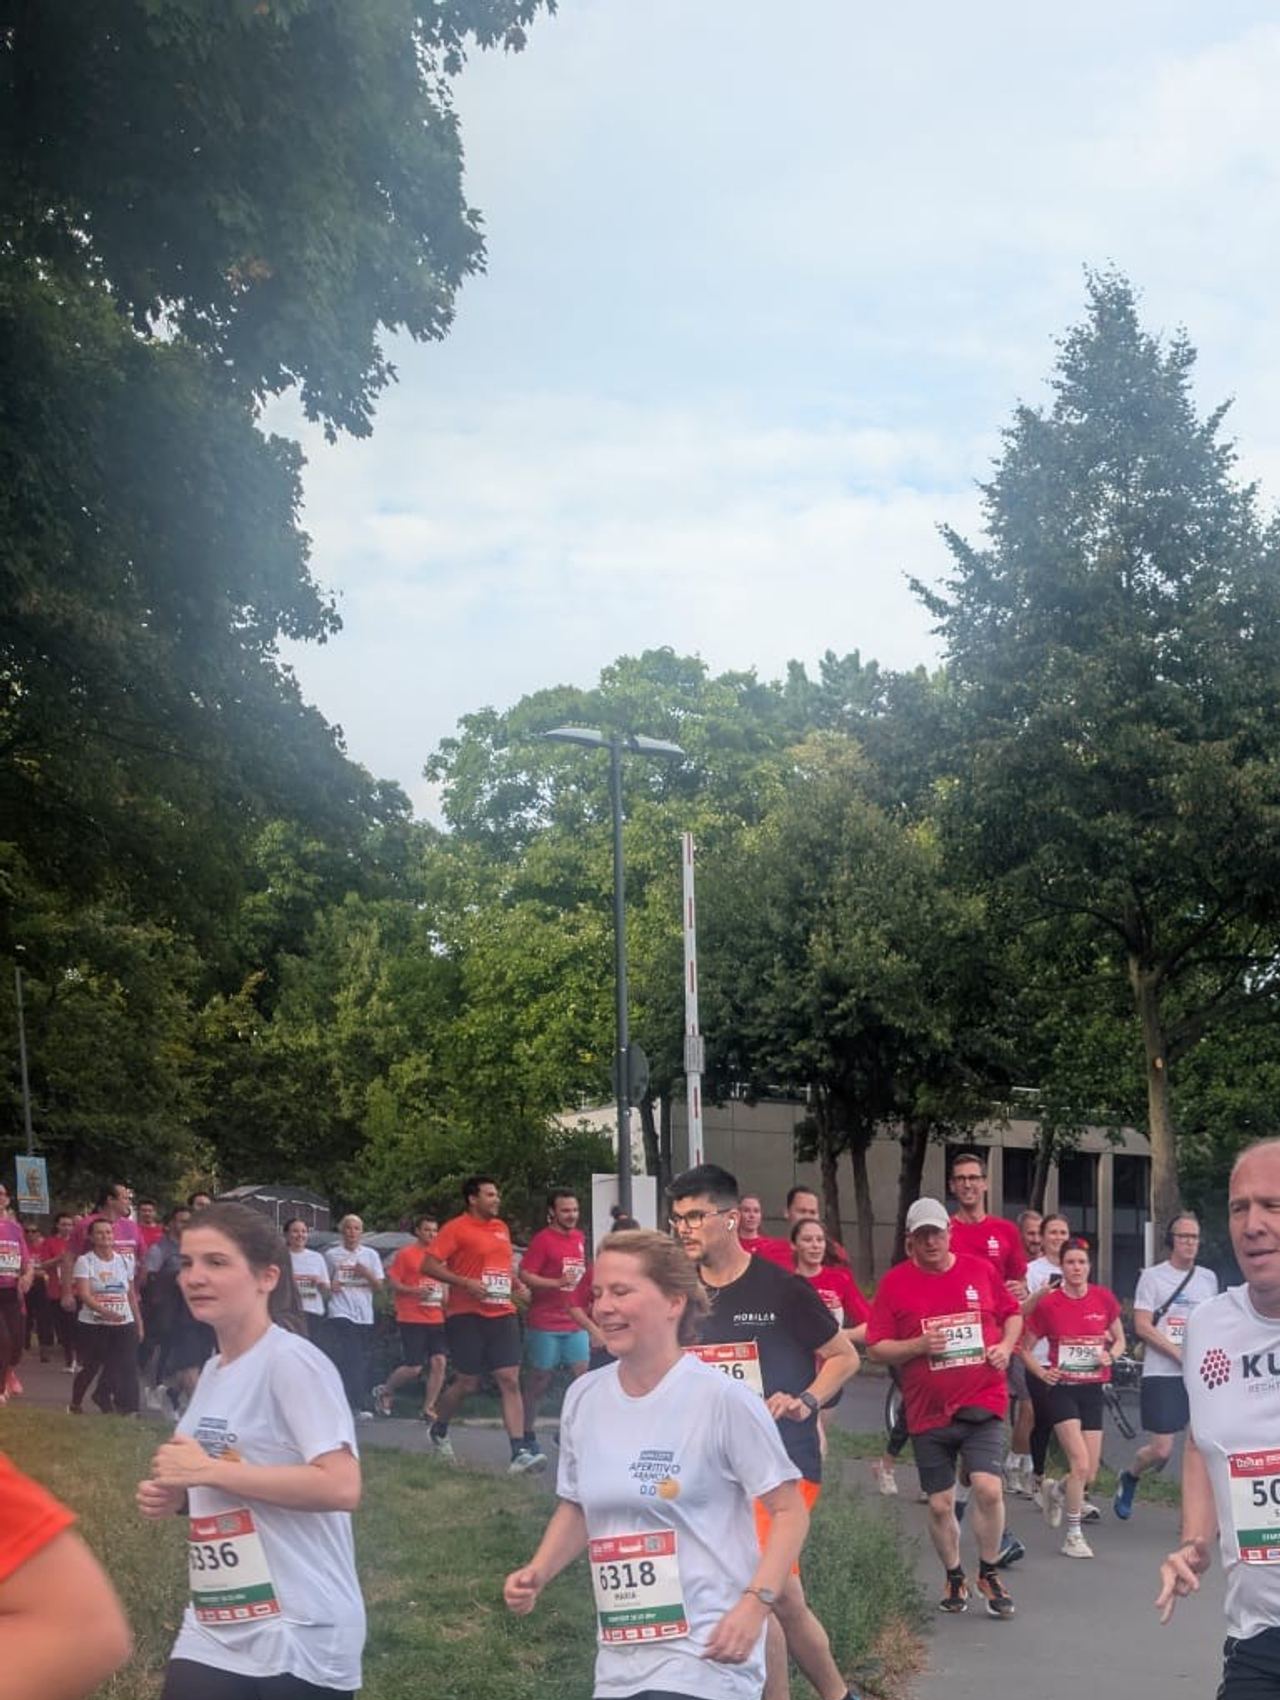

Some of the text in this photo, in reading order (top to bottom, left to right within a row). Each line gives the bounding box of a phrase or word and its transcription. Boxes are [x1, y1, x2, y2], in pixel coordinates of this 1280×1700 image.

[945, 1326, 973, 1341] 943
[629, 1462, 681, 1475] APERITIVO
[600, 1561, 656, 1591] 6318
